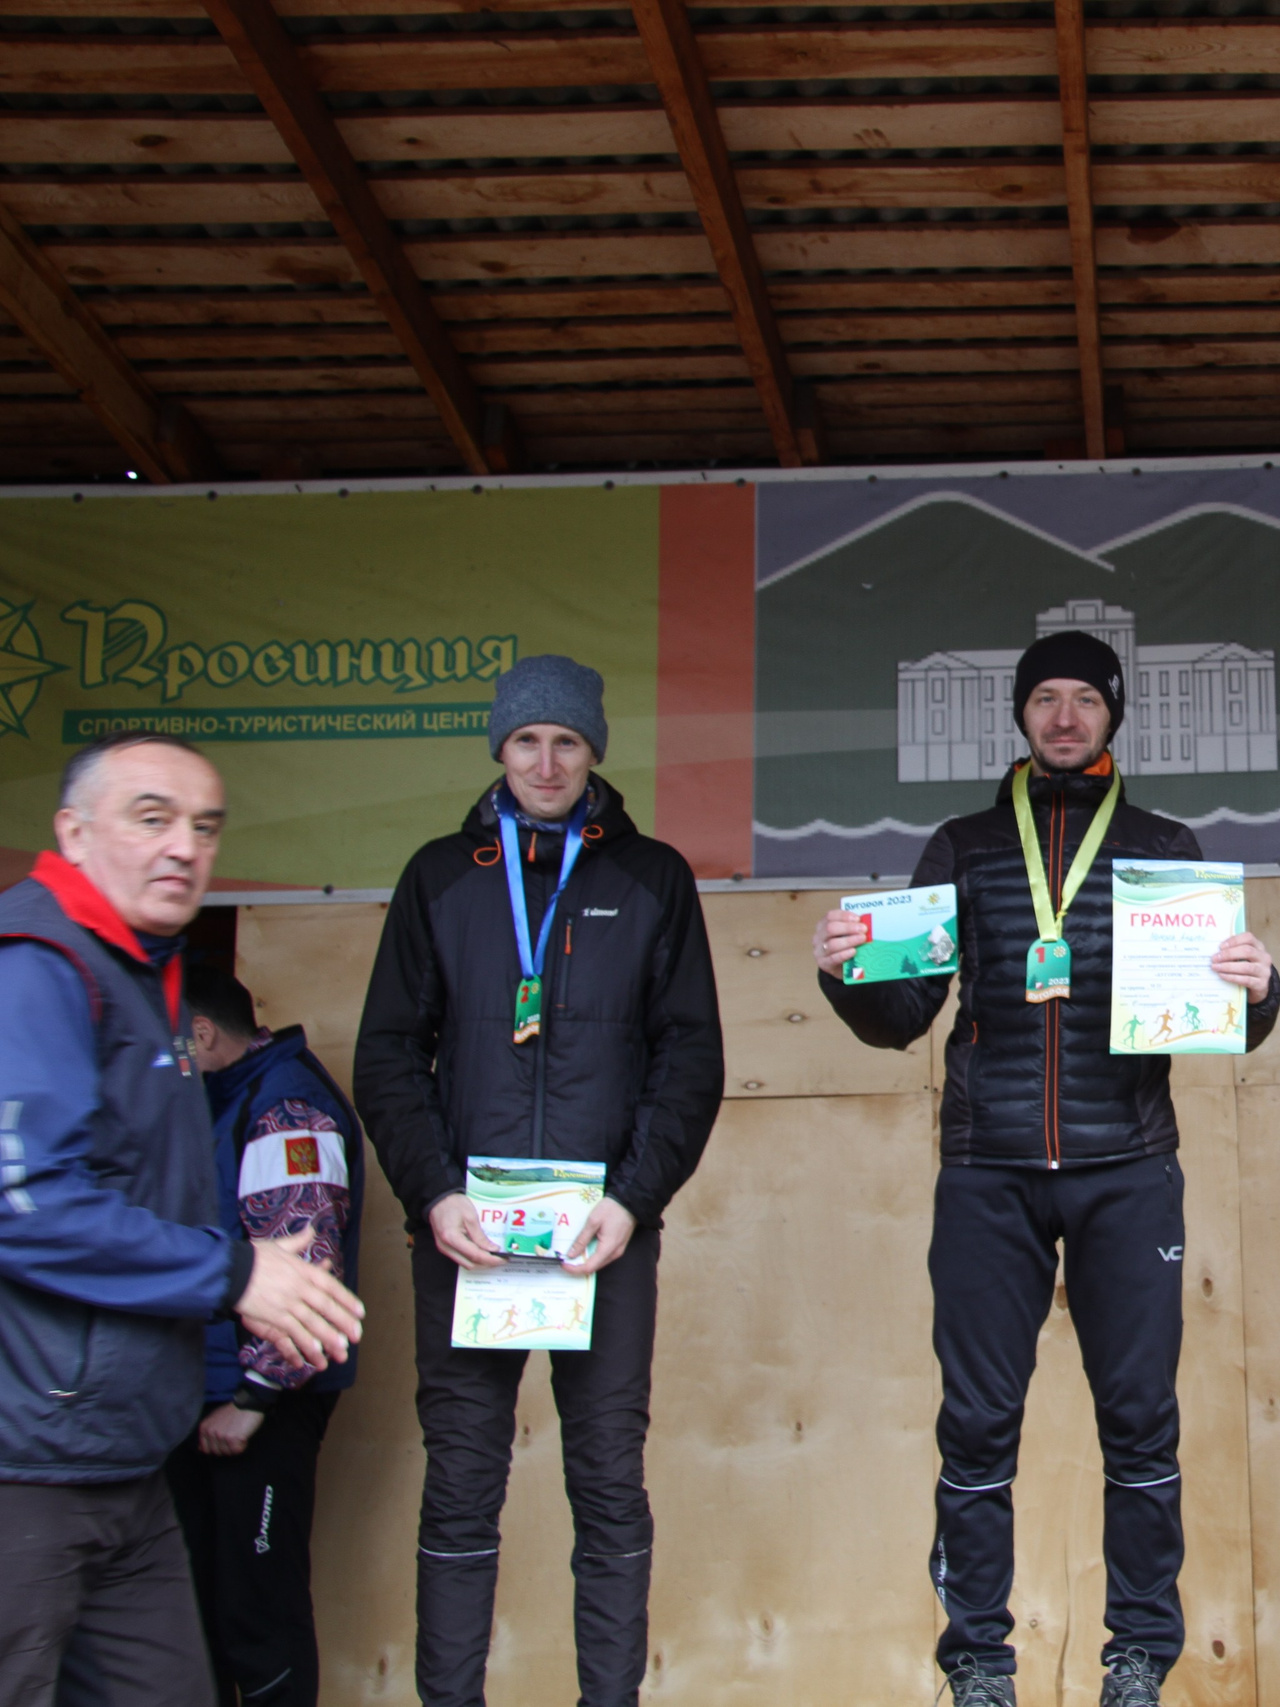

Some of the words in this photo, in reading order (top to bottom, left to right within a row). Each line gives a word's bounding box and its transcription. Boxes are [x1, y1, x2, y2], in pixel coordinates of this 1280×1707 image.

[60, 599, 518, 704] Провинция
[77, 709, 417, 736] СПОРТИВНО-ТУРИСТИЧЕСКИЙ
[886, 895, 912, 906] 2023
[1130, 913, 1217, 928] ГРАМОТА
[1035, 946, 1045, 963] 1
[511, 1208, 526, 1227] 2
